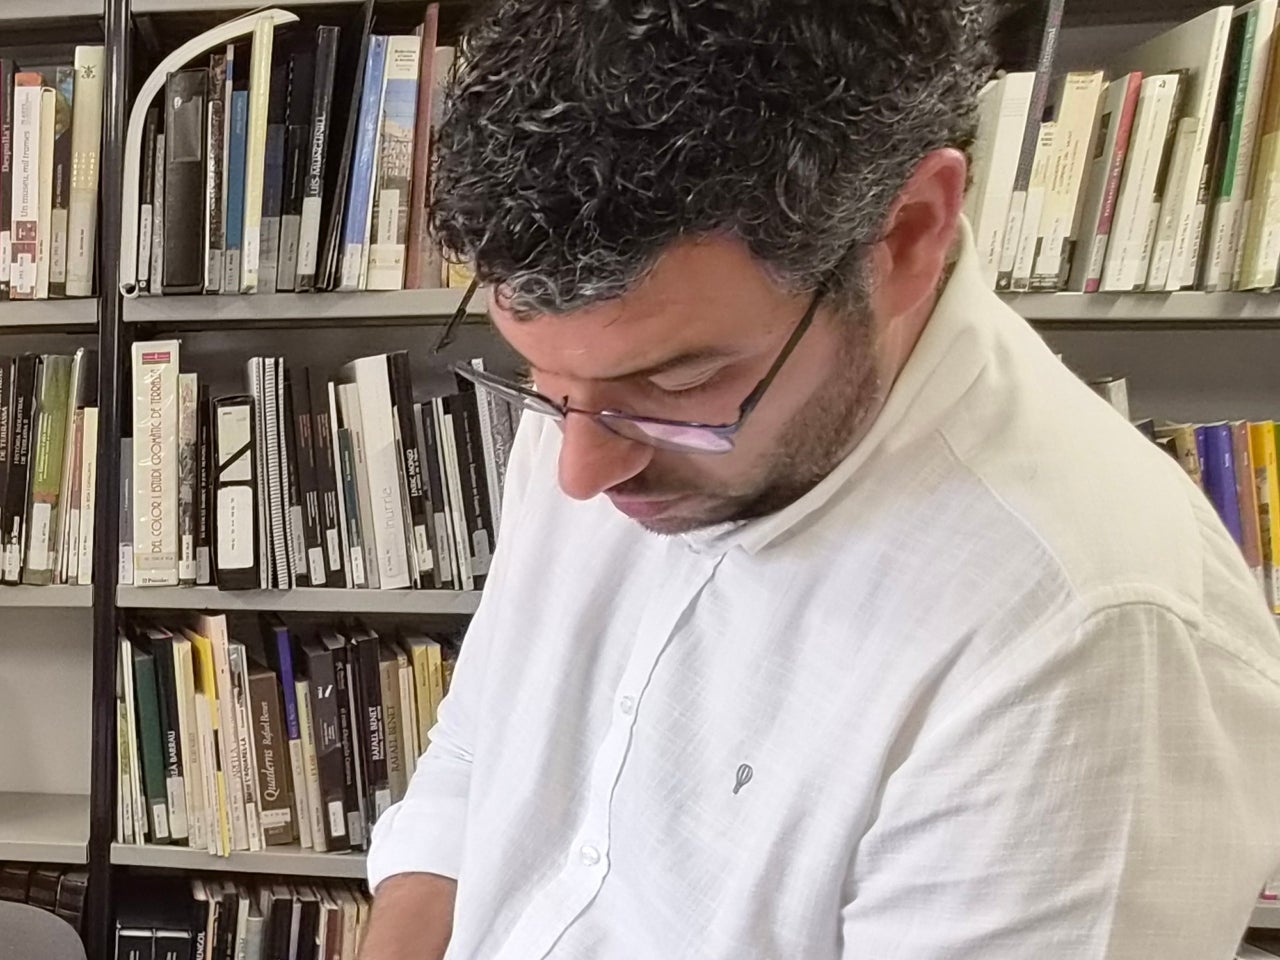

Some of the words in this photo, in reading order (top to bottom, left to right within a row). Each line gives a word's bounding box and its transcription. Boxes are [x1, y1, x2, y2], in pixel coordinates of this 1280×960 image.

[20, 205, 29, 217] Un
[151, 407, 161, 418] DE
[151, 501, 162, 536] COLOR
[151, 539, 162, 553] DEL
[387, 705, 397, 735] BENET
[262, 722, 272, 745] Rafael
[389, 736, 400, 772] RAFAEL
[260, 749, 279, 801] Quaderns
